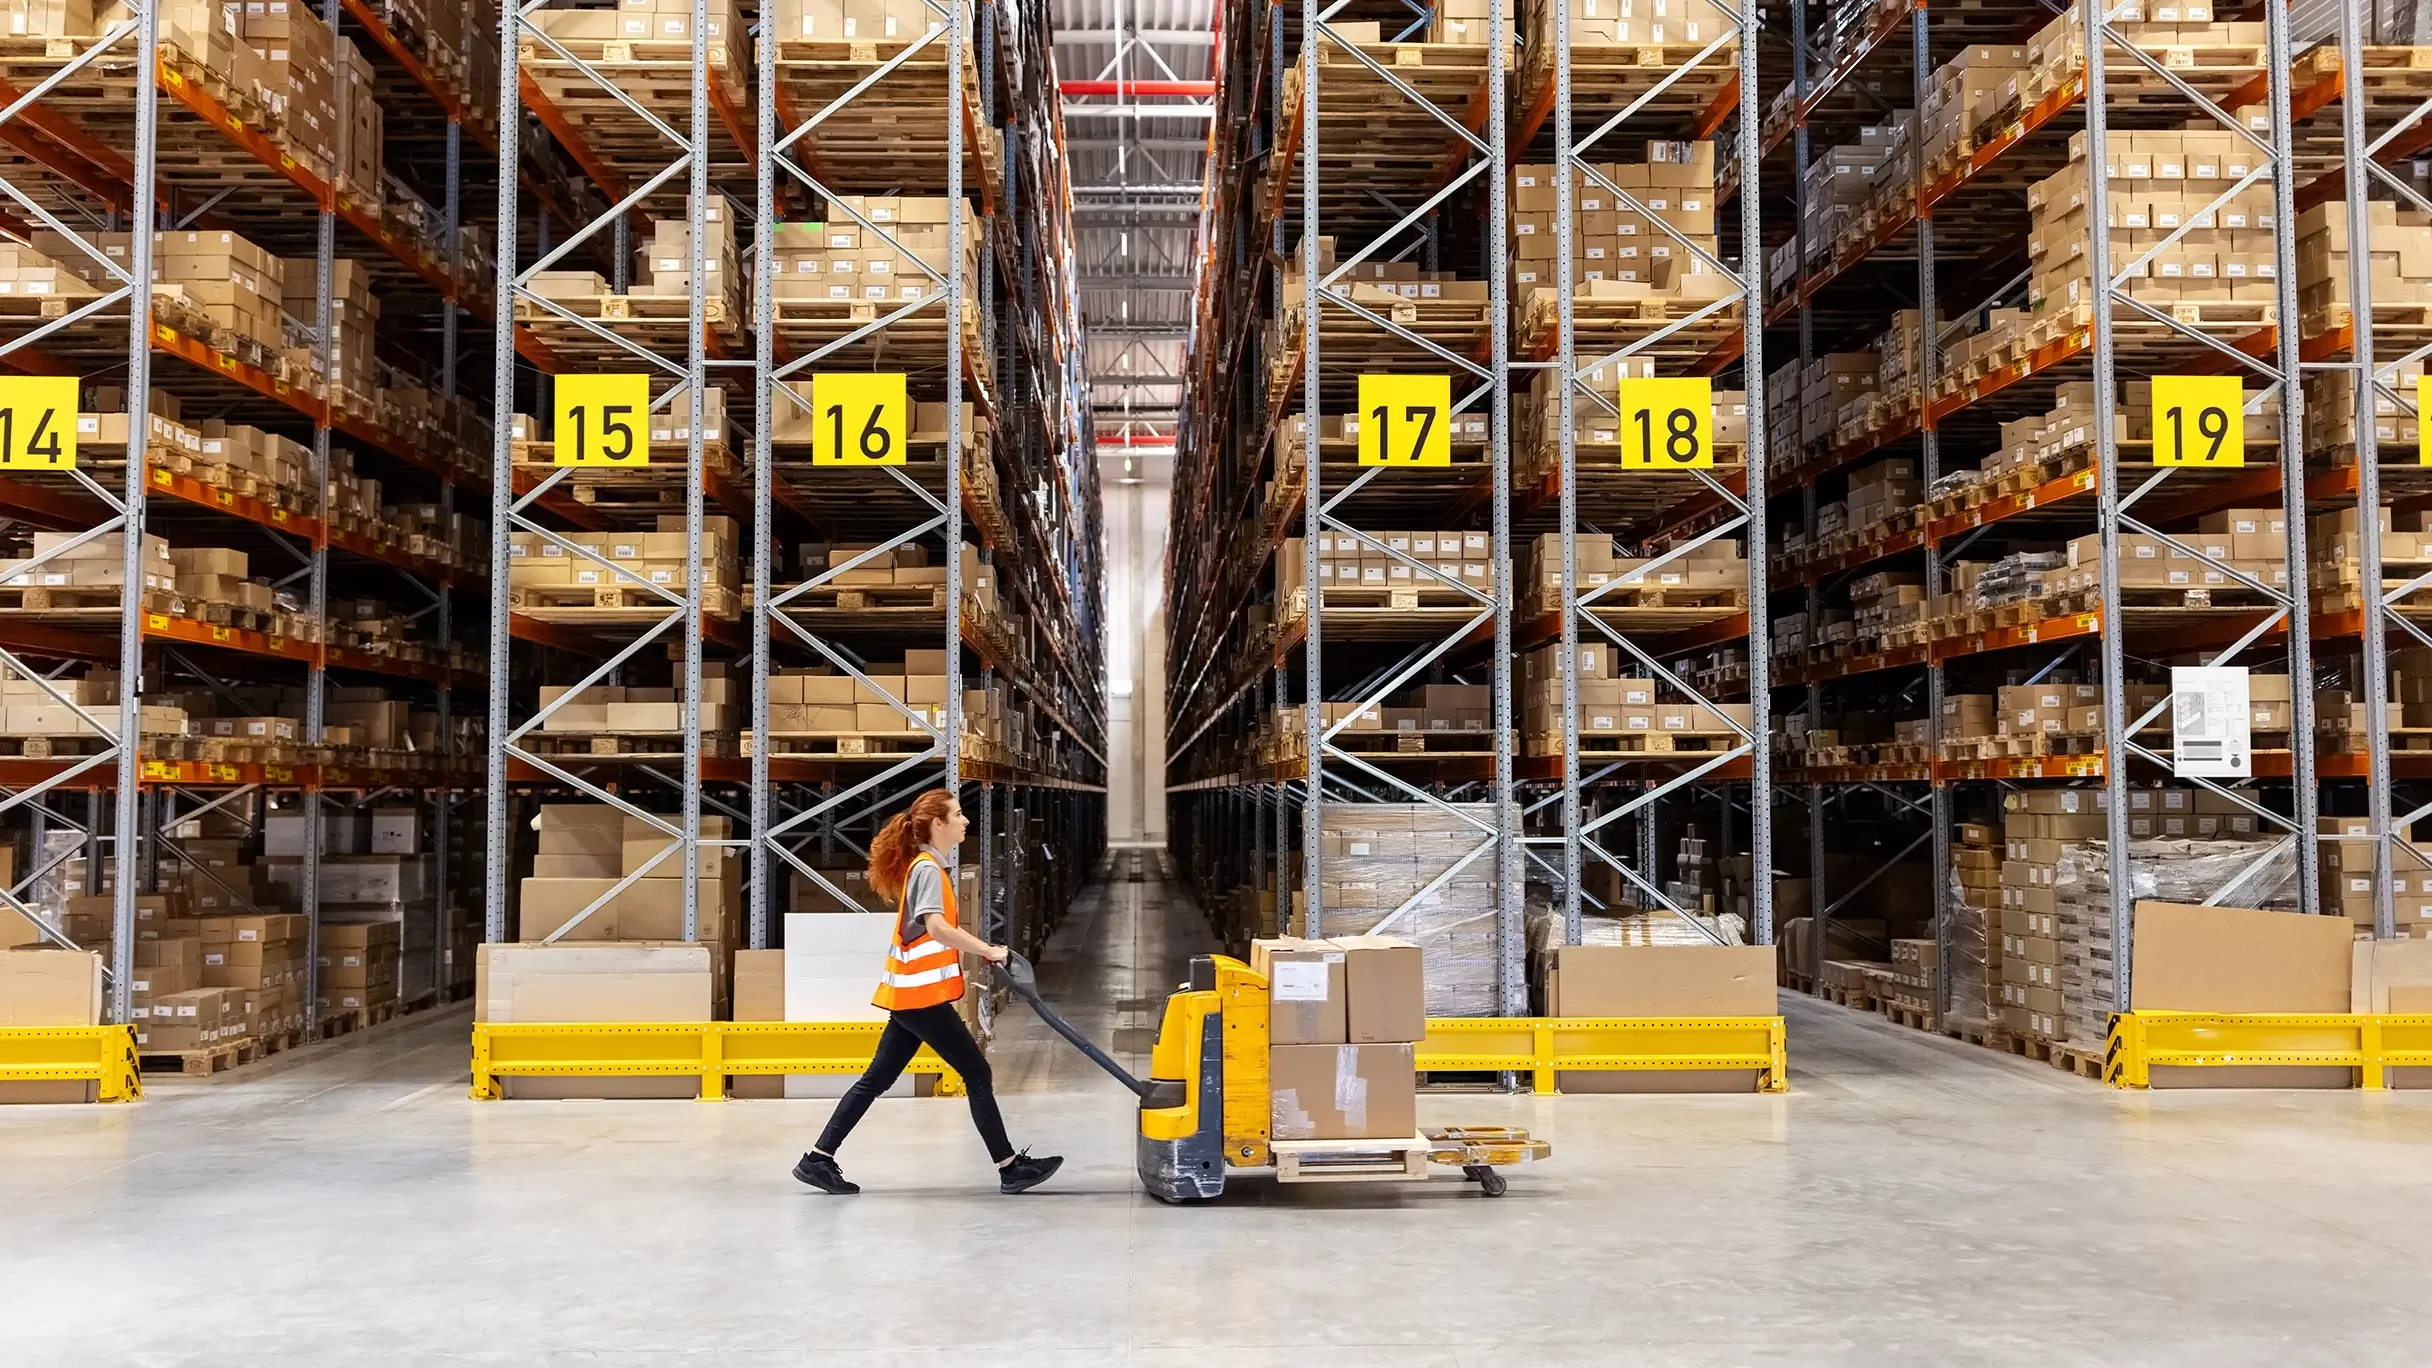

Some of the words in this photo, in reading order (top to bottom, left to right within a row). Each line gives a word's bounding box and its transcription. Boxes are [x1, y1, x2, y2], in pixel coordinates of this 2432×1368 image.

[0, 408, 62, 463] 14
[569, 405, 633, 460] 15
[827, 404, 891, 459] 16
[1372, 405, 1437, 460] 17
[1634, 408, 1699, 463] 18
[2166, 406, 2229, 461] 19
